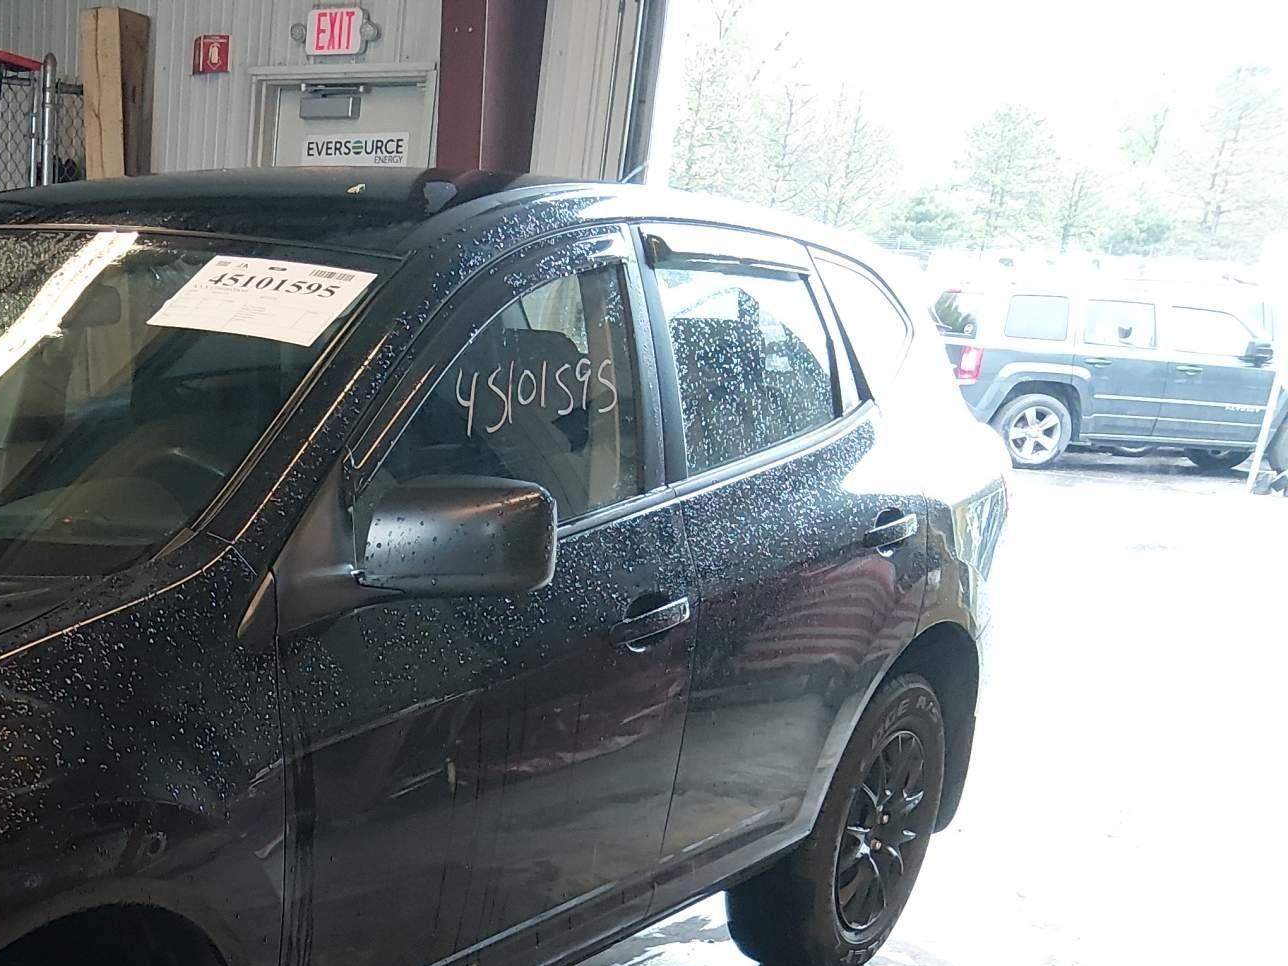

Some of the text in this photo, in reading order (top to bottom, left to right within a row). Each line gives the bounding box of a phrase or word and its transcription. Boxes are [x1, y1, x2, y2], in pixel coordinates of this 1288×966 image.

[315, 11, 355, 51] EXIT
[306, 138, 404, 157] EVERSOURCE
[374, 155, 403, 164] ENERGY
[208, 272, 341, 298] 45101595
[455, 358, 618, 438] 45101595
